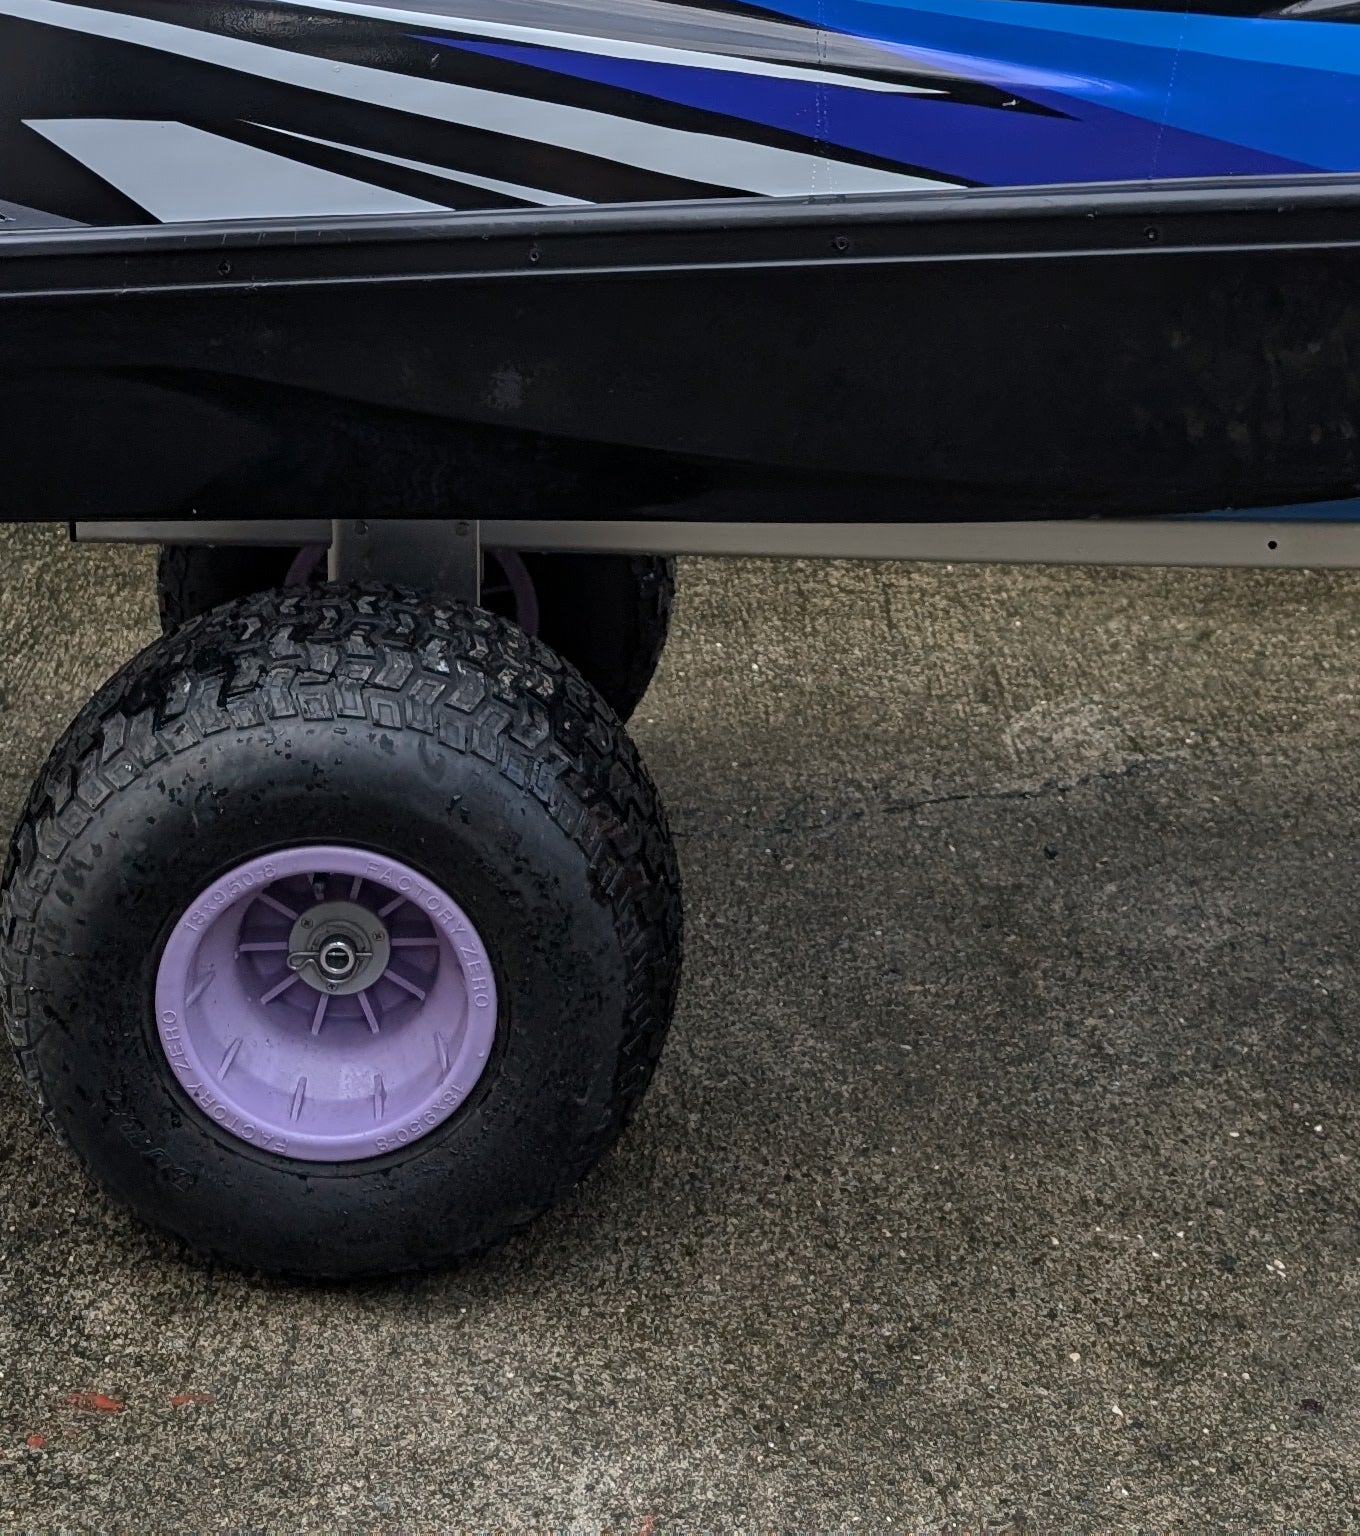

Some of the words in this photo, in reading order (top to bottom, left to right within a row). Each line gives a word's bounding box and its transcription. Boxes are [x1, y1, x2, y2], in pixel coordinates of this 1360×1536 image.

[365, 861, 468, 935] FACTORY
[459, 942, 490, 1009] ZERO
[161, 1010, 193, 1073] ZERO
[185, 1081, 289, 1154] FACTORY
